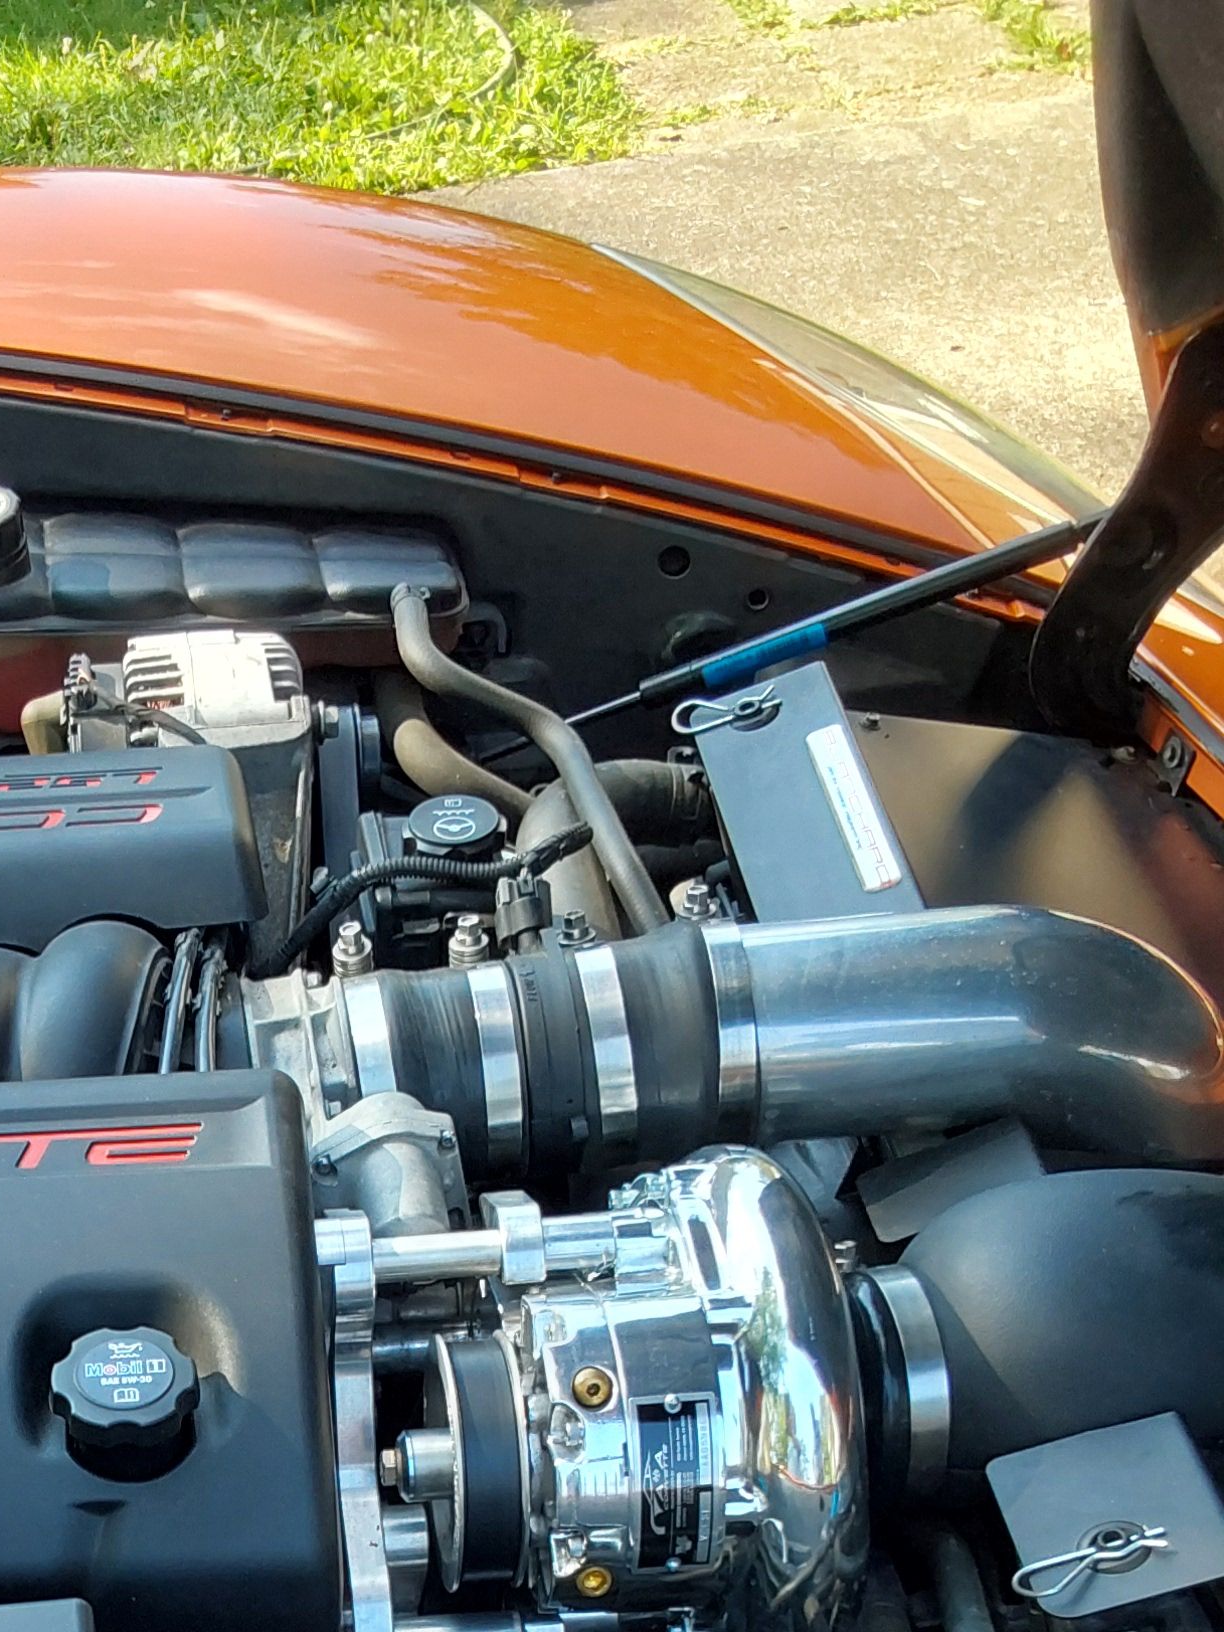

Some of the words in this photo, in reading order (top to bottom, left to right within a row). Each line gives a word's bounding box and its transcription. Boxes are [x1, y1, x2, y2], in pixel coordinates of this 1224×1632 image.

[85, 1360, 143, 1377] Mobil
[101, 1376, 120, 1386] SAE
[121, 1375, 153, 1385] 5W-30
